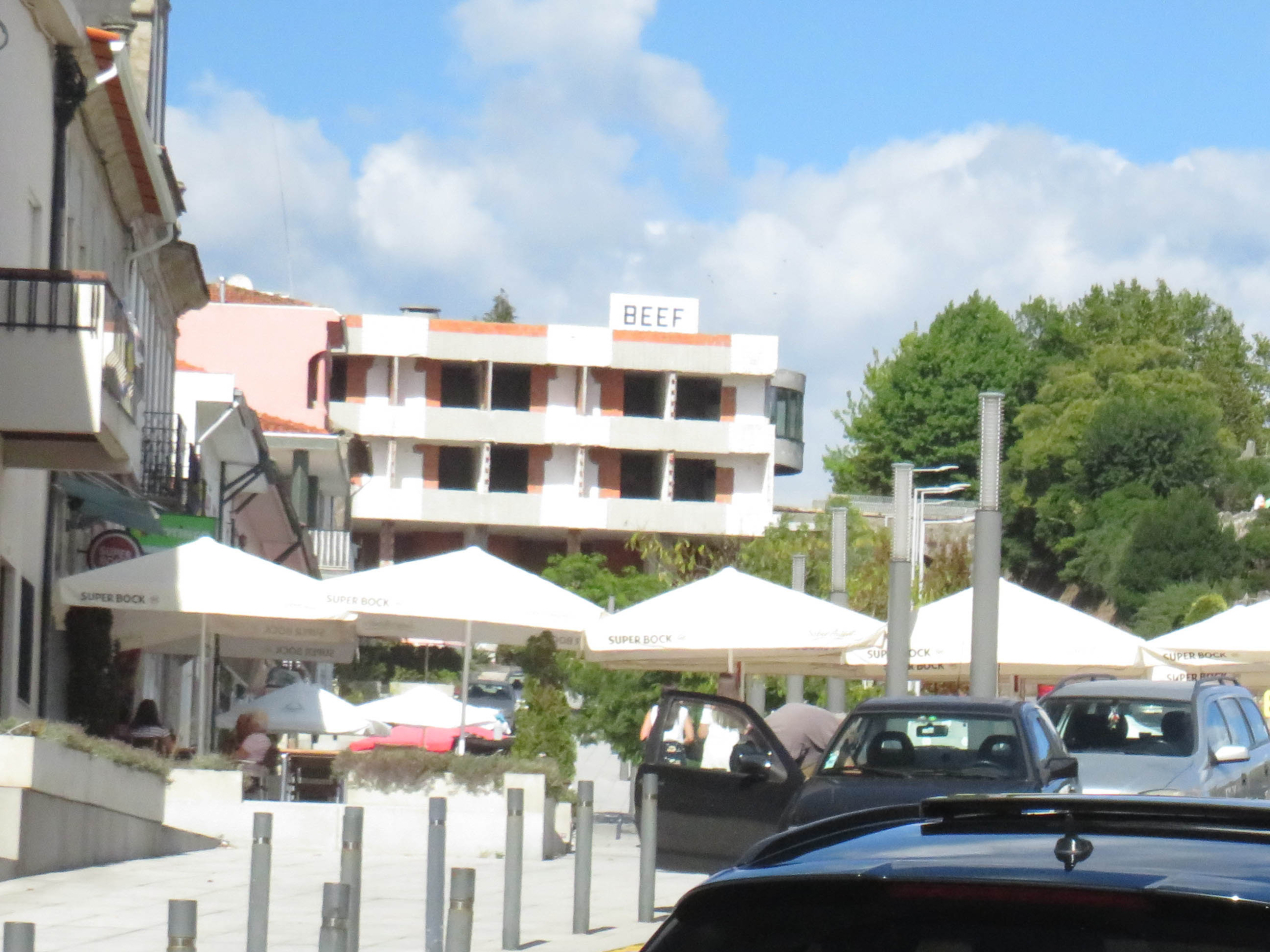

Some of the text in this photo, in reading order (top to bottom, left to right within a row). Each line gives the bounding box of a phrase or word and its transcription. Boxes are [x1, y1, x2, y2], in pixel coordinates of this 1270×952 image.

[624, 305, 684, 327] BEEF
[80, 592, 146, 604] SUPER BOCK
[326, 594, 389, 607] SUPER BOCK
[608, 634, 673, 645] SUPER BOCK
[909, 648, 931, 658] OCK
[1162, 651, 1227, 661] SUPER BOCK
